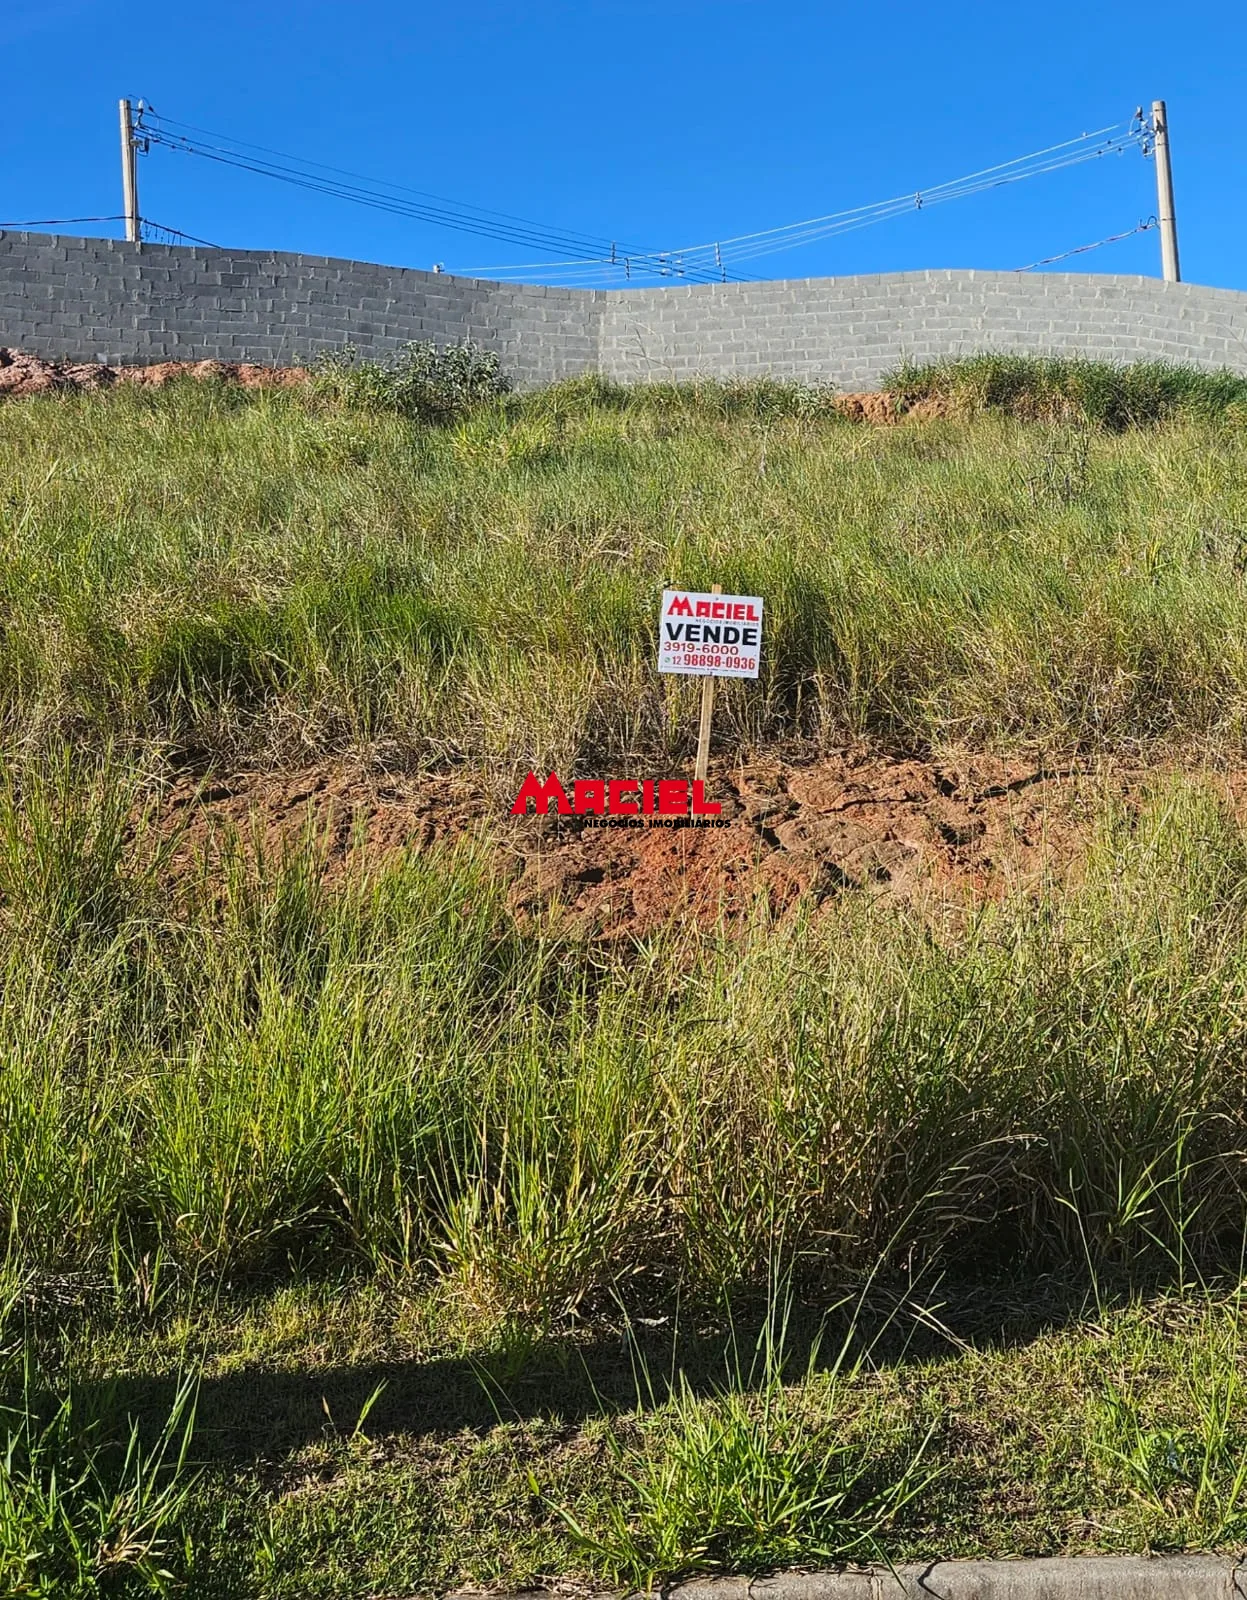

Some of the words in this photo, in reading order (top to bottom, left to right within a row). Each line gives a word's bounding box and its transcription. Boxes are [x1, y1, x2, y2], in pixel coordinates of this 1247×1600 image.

[667, 595, 759, 621] MACIEL
[665, 623, 757, 646] VENDE
[664, 641, 739, 655] 3919-6000
[672, 656, 681, 665] 12
[684, 654, 756, 670] 98898-0936
